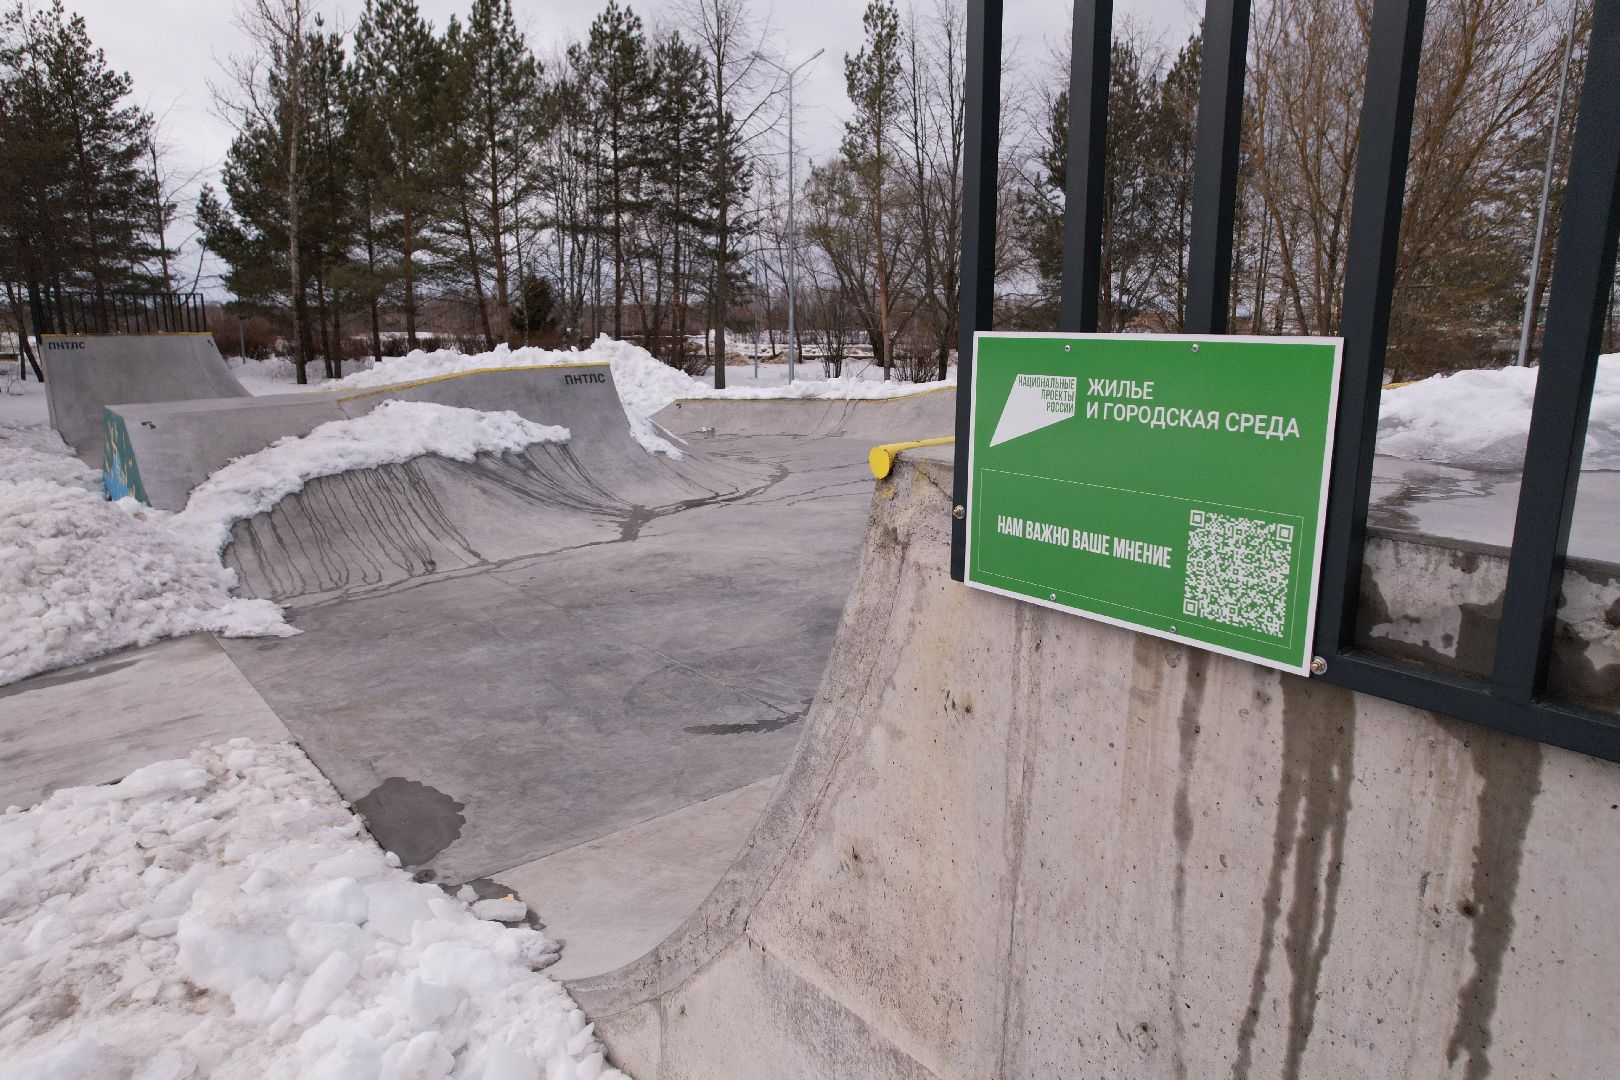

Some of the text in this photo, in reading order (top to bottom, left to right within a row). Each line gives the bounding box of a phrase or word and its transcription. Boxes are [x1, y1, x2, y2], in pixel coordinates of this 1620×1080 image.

[564, 373, 605, 385] ПНТЛС
[1018, 376, 1075, 389] НАЦИОНАЛЬНЫЕ
[1087, 378, 1154, 399] ЖИЛЬЕ
[1041, 389, 1074, 402] ПРОЕКТЫ
[1046, 401, 1073, 413] РОССИИ
[1086, 402, 1300, 441] И ГОРОДСКАЯ СРЕДА
[997, 515, 1172, 569] НАМ ВАЖНО ВАШЕ МНЕНИЕ
